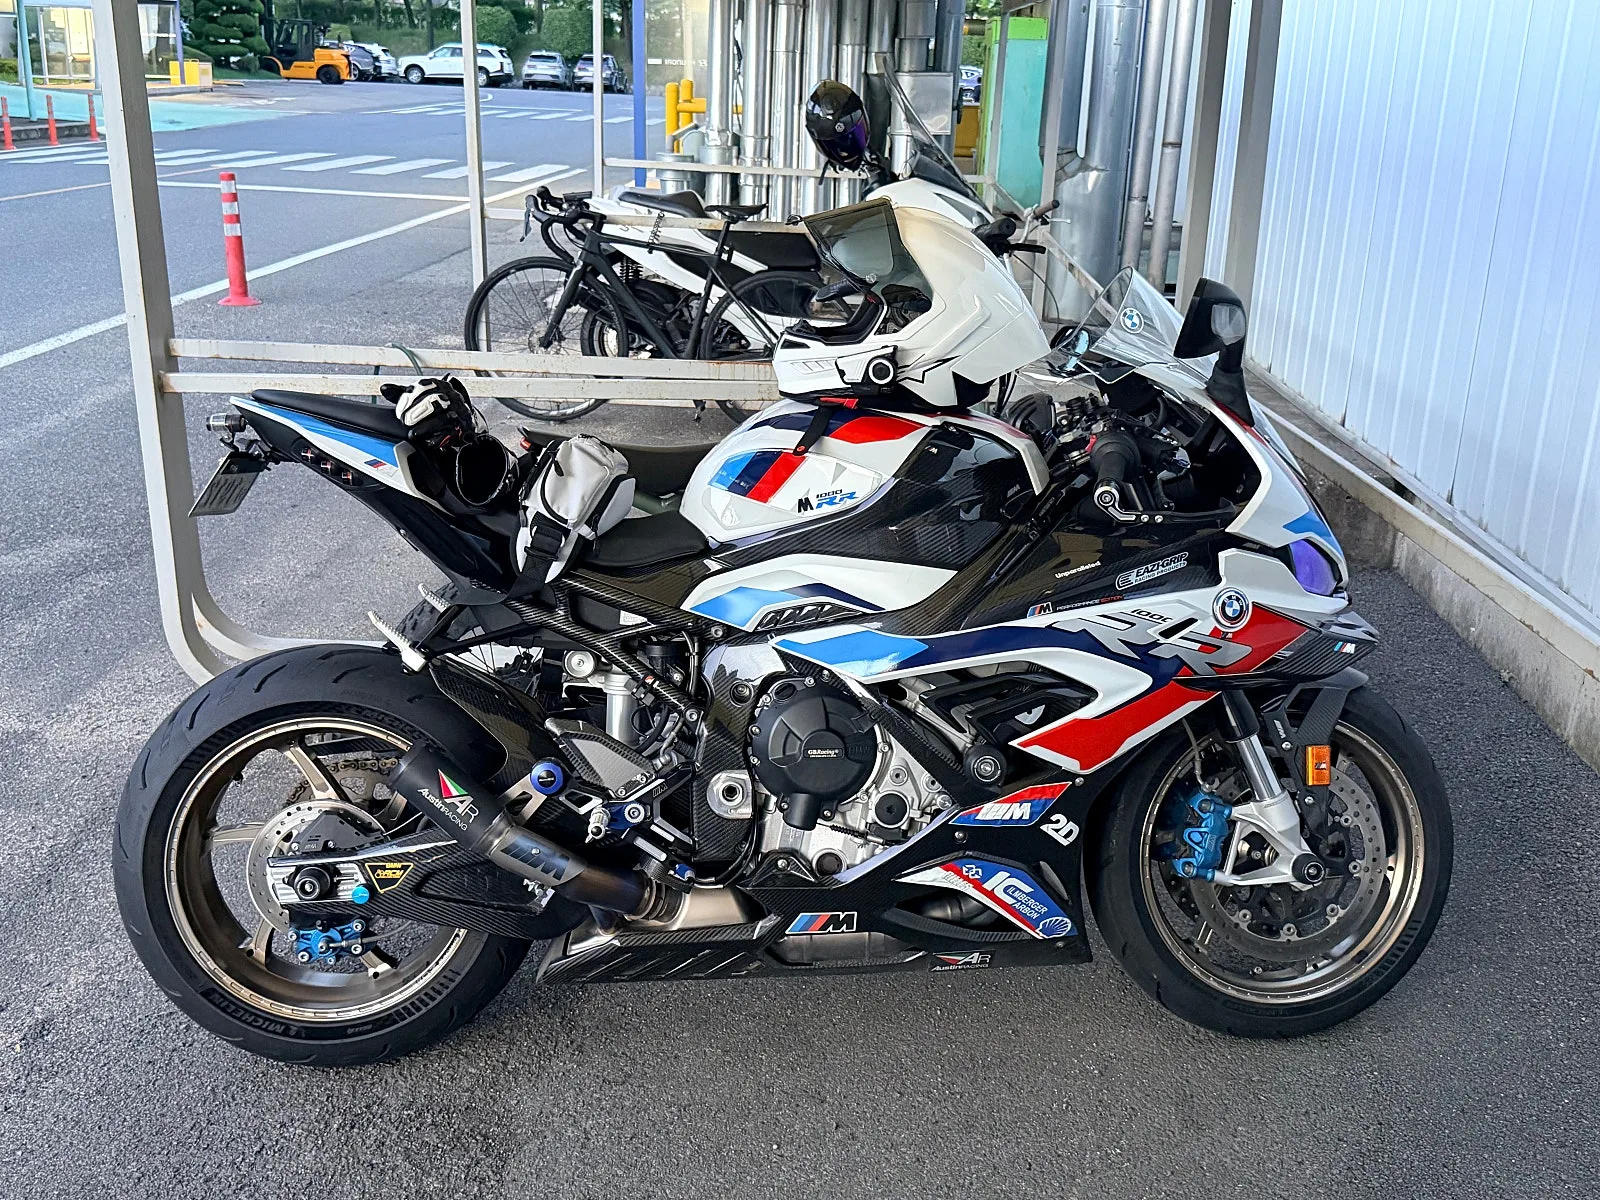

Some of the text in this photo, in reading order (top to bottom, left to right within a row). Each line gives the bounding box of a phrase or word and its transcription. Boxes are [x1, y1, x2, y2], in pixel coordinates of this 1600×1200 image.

[798, 489, 843, 513] M 1000
[816, 491, 859, 509] RR
[1006, 886, 1048, 915] ILMBERGER
